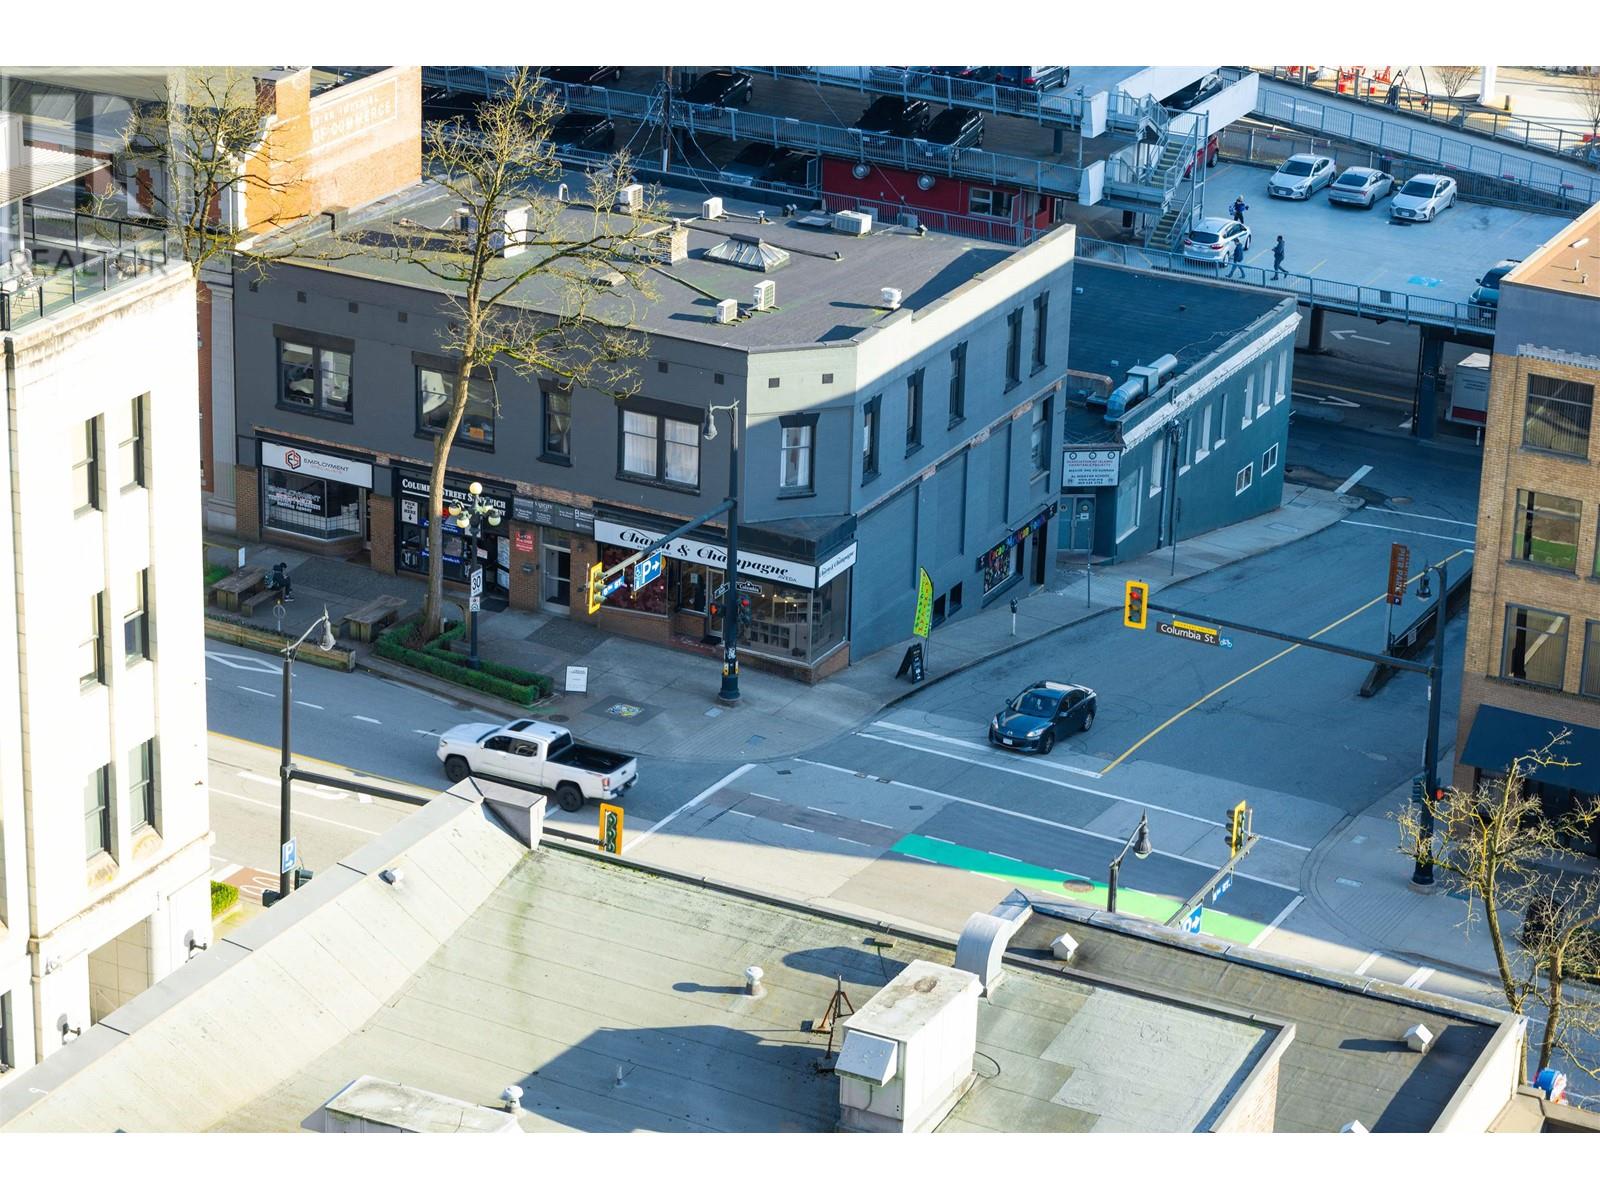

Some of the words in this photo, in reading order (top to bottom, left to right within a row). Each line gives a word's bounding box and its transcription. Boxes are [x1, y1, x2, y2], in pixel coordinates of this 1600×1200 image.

[303, 458, 349, 472] EMPLOYMENT
[677, 545, 690, 557] &
[472, 575, 481, 591] 30
[1160, 623, 1201, 641] Columbia
[1204, 633, 1216, 644] St.
[285, 843, 293, 863] P
